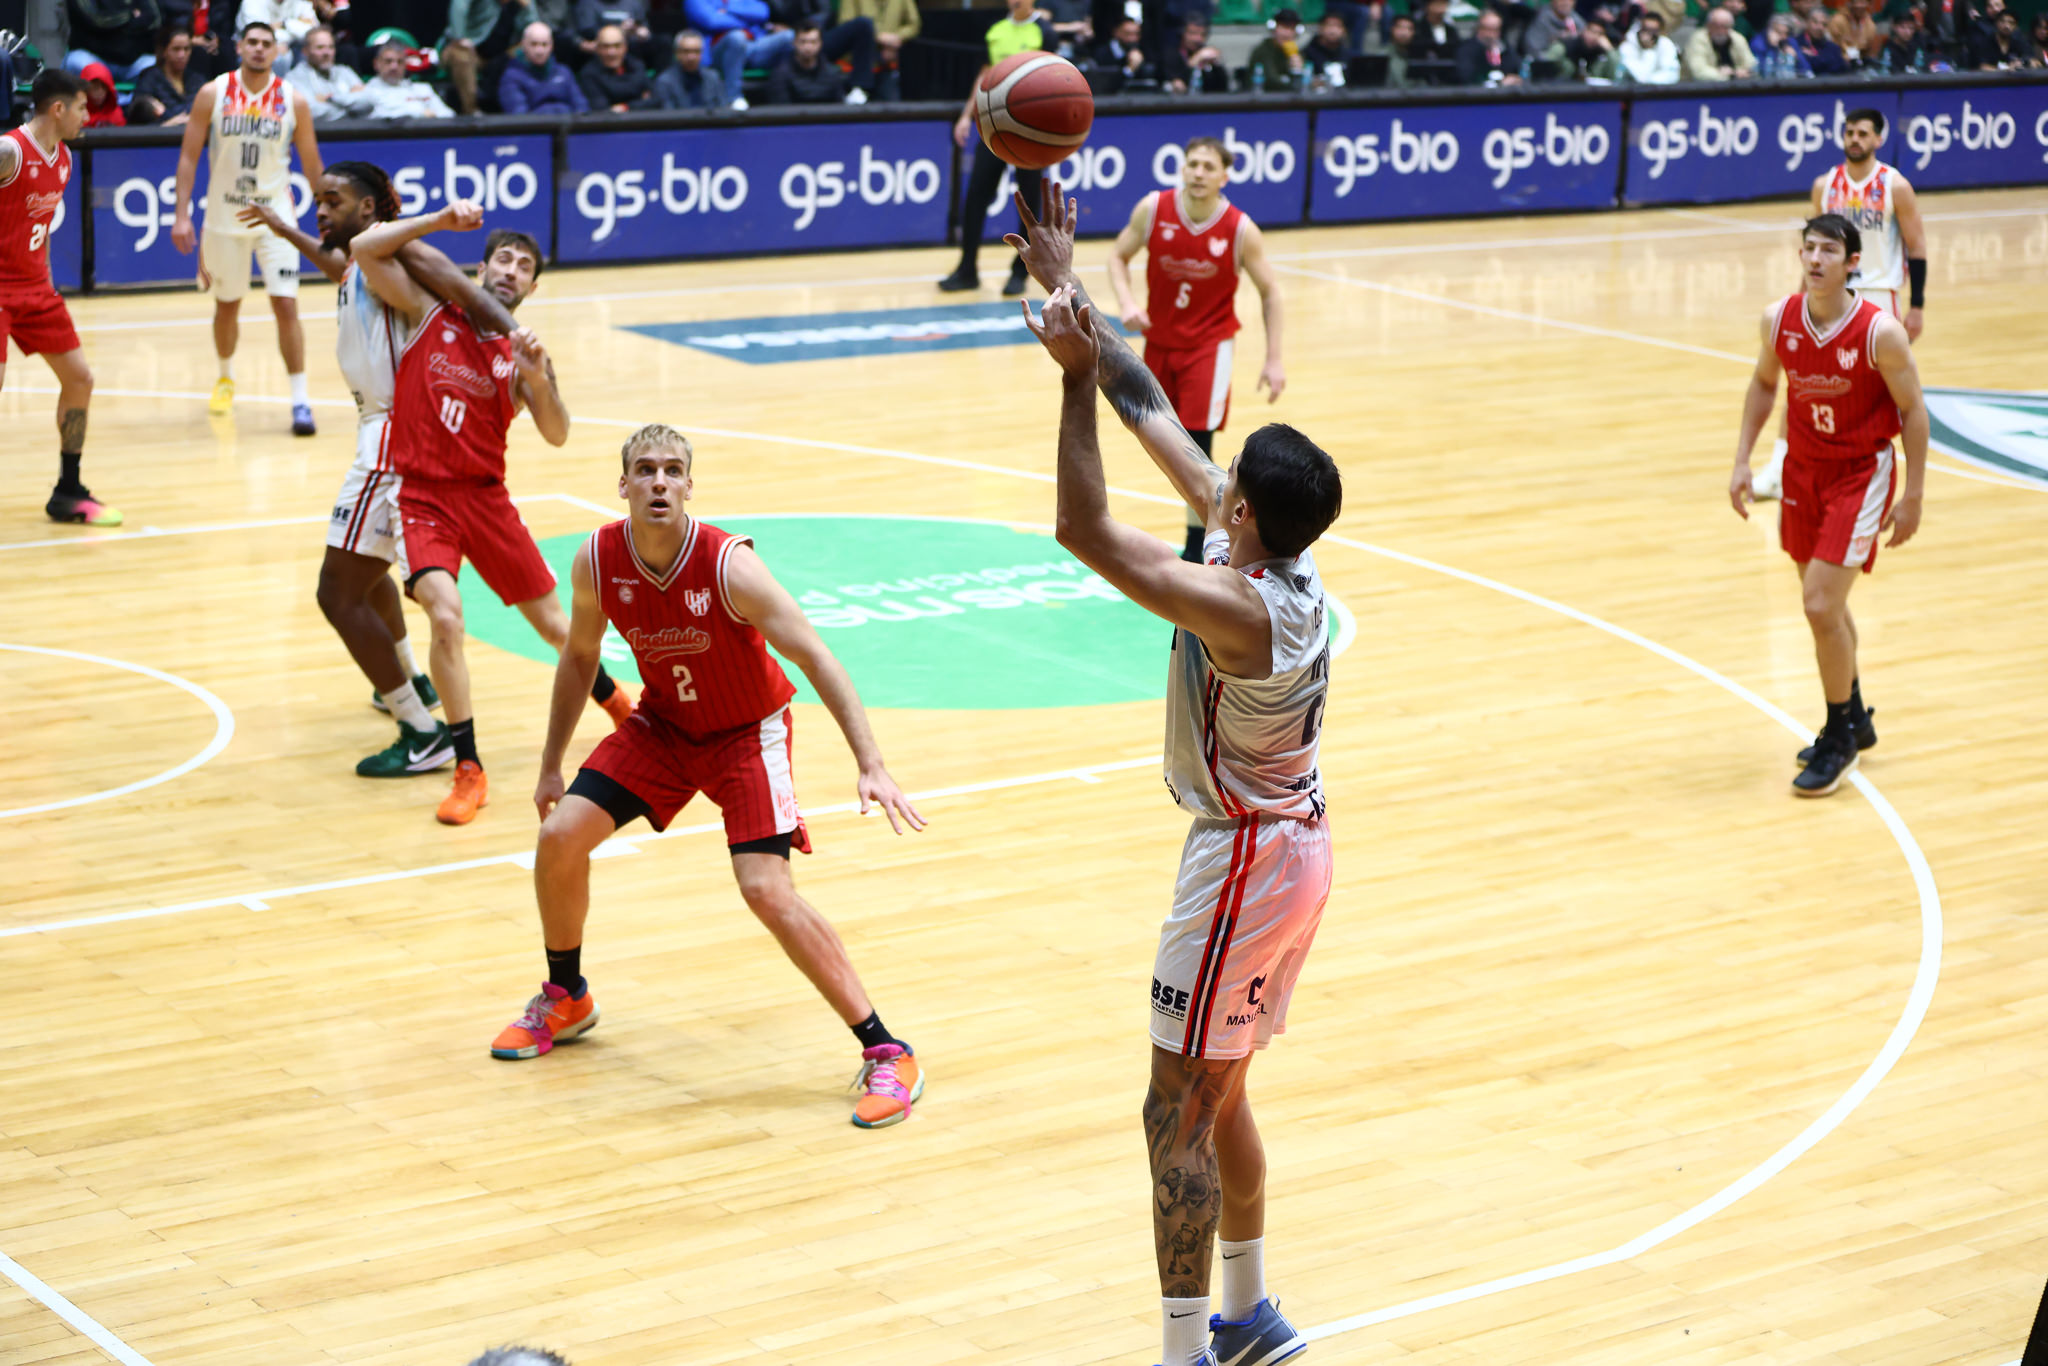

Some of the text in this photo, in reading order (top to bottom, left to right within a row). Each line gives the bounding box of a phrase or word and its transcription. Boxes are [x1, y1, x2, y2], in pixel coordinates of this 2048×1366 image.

[241, 141, 260, 170] 10
[440, 395, 467, 434] 10
[1811, 403, 1836, 434] 13
[672, 665, 697, 702] 2
